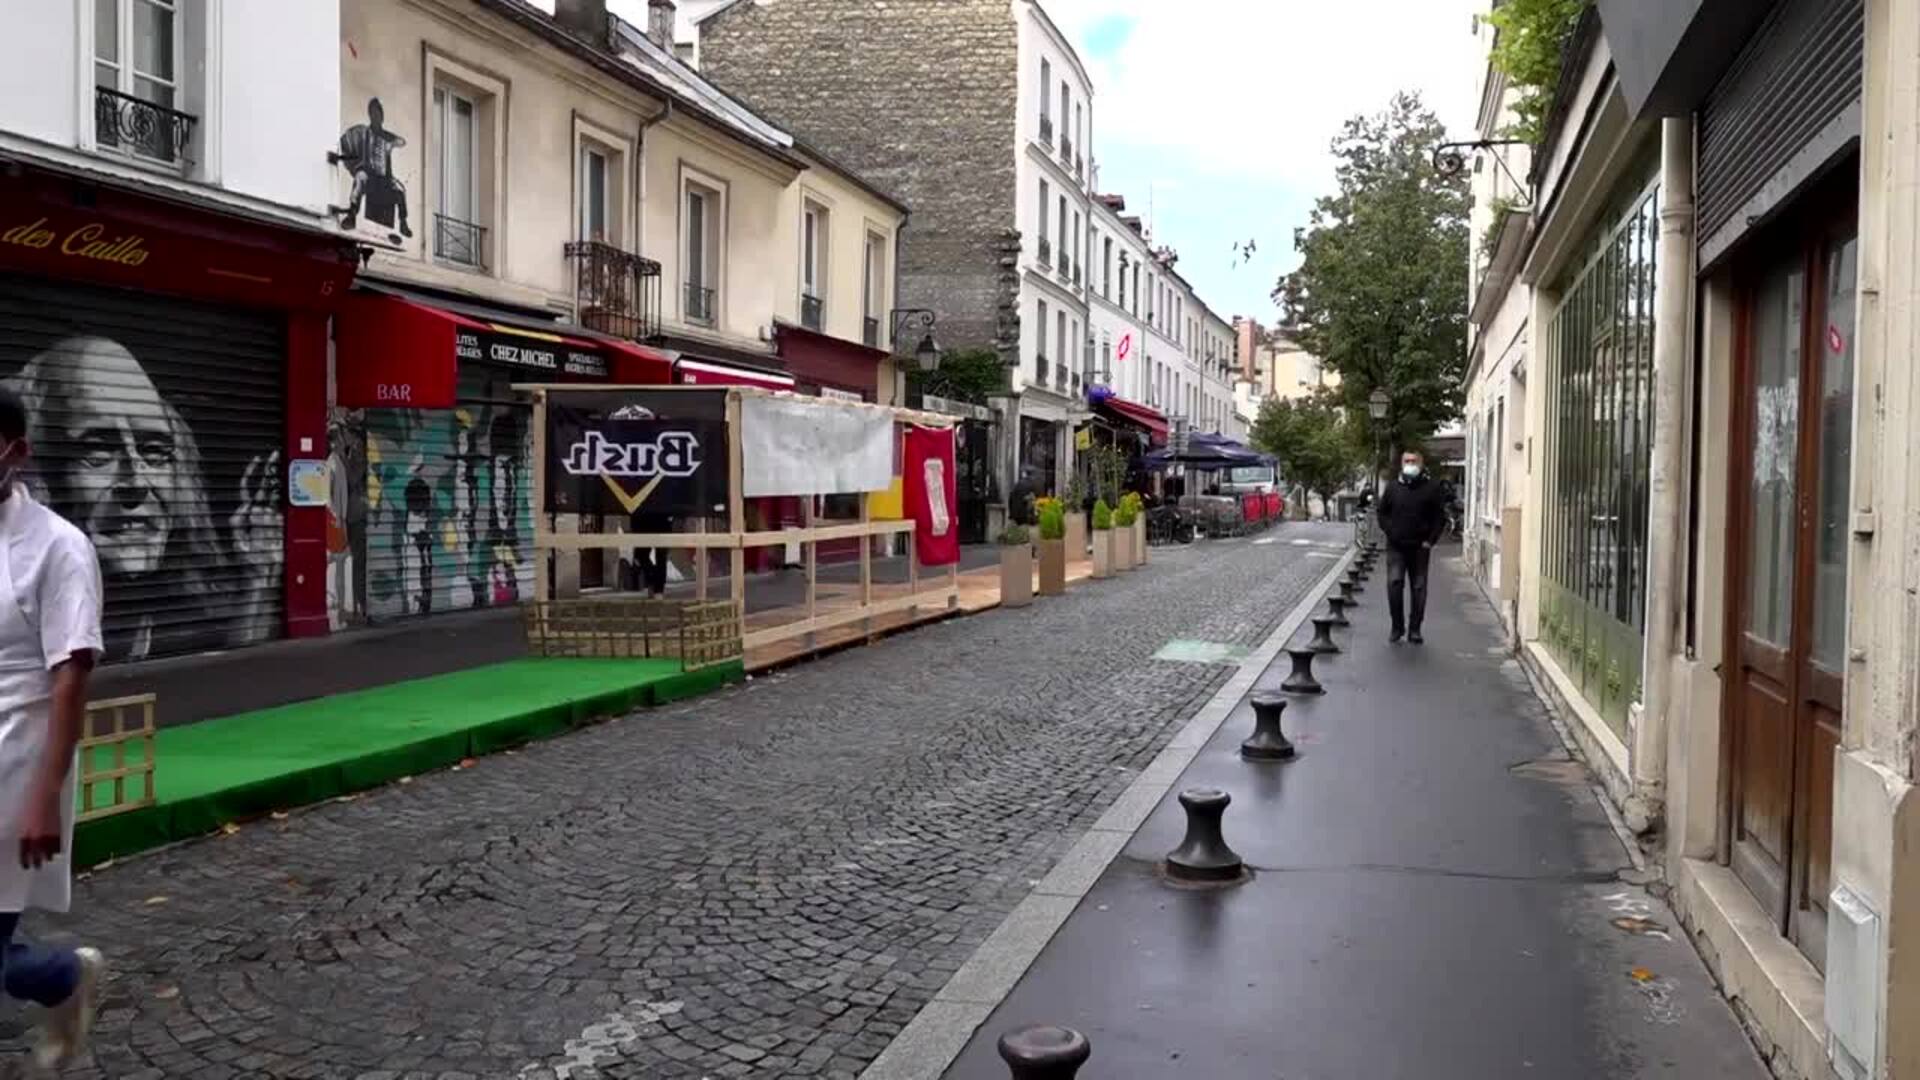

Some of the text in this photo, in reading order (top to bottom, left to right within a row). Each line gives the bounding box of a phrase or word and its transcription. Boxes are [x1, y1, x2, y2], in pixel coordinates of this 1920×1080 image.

[2, 217, 149, 266] des Cailles
[490, 344, 519, 363] CHEZ
[520, 350, 557, 369] MICHEL
[377, 384, 412, 402] BAR
